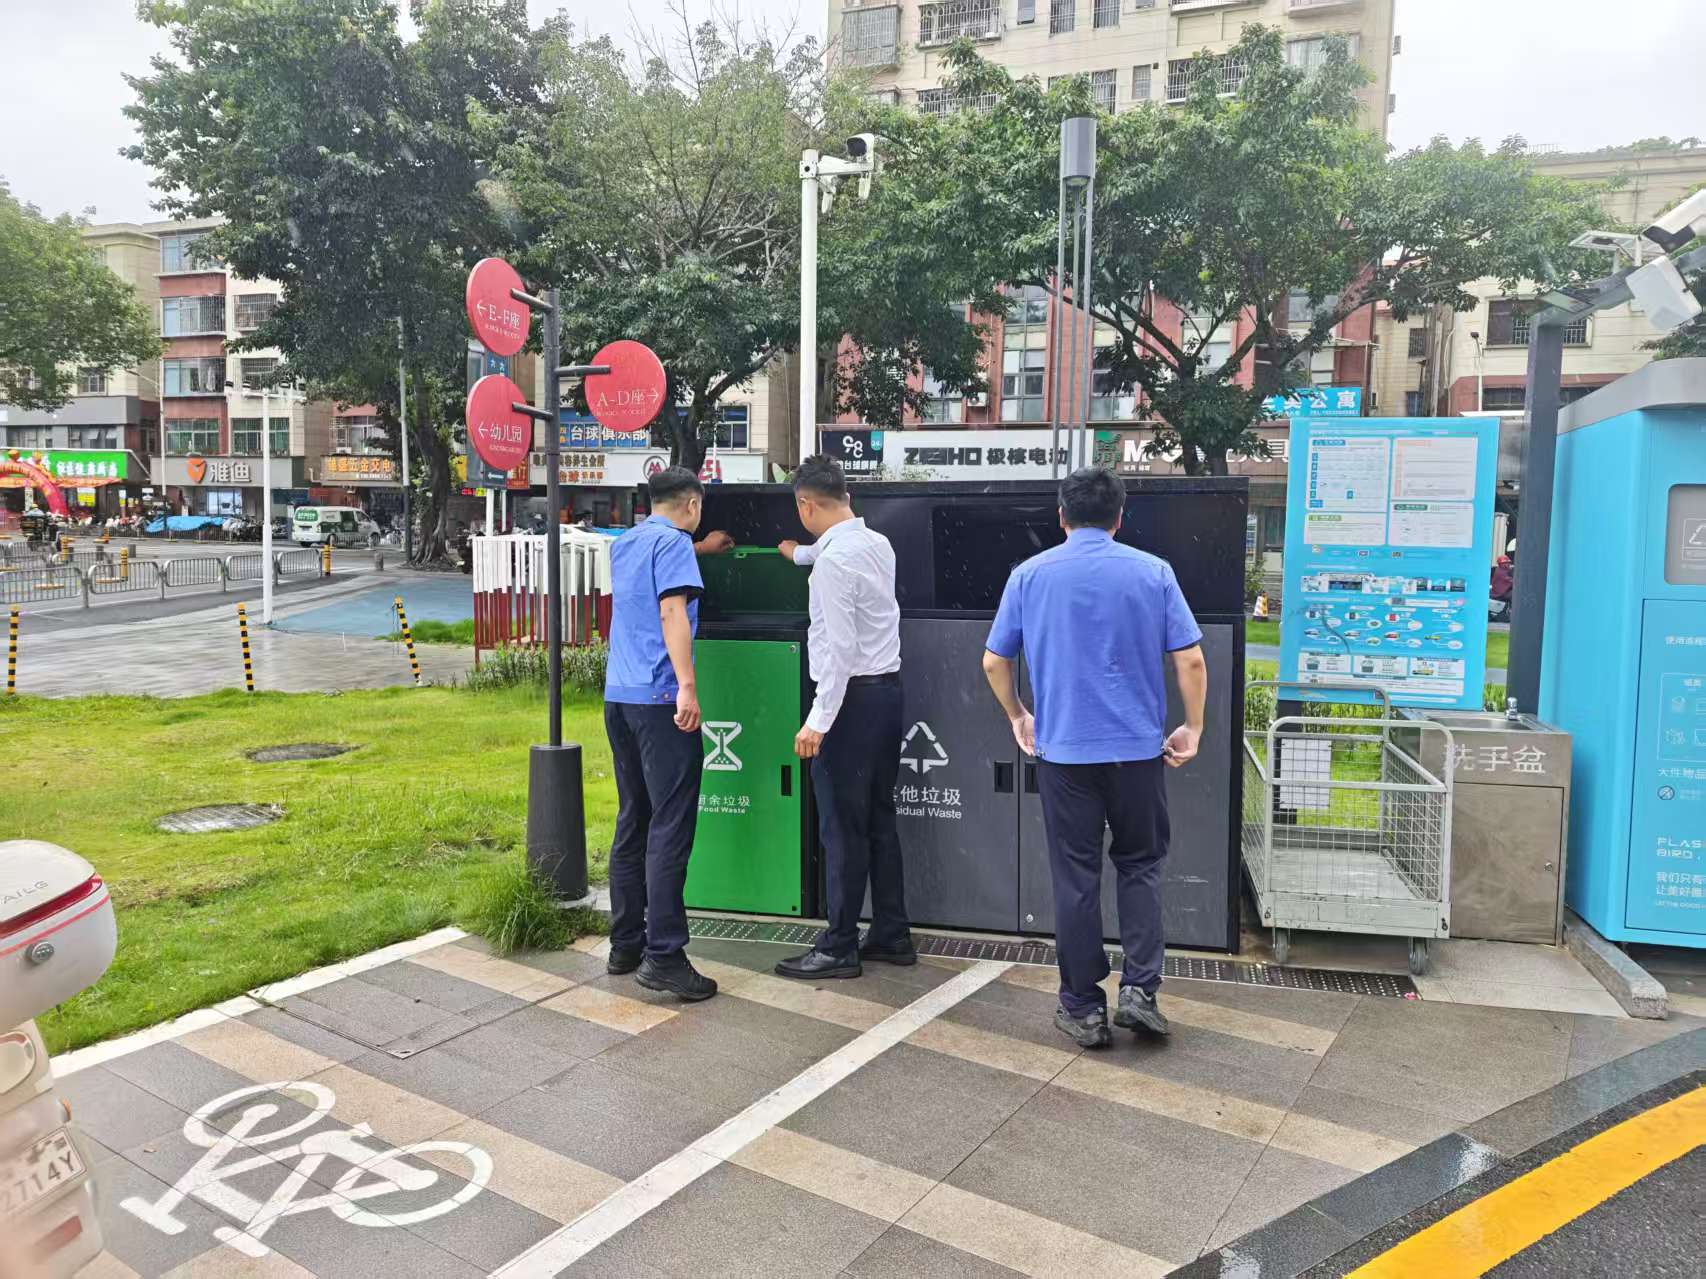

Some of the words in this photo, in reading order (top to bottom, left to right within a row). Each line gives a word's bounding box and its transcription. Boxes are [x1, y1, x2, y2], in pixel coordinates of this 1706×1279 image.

[597, 389, 645, 408] A-D座
[490, 423, 522, 443] 幼儿园
[987, 447, 1068, 466] 极核电动
[209, 461, 251, 482] 雅迪
[721, 806, 746, 814] Waste
[928, 807, 962, 819] Waste
